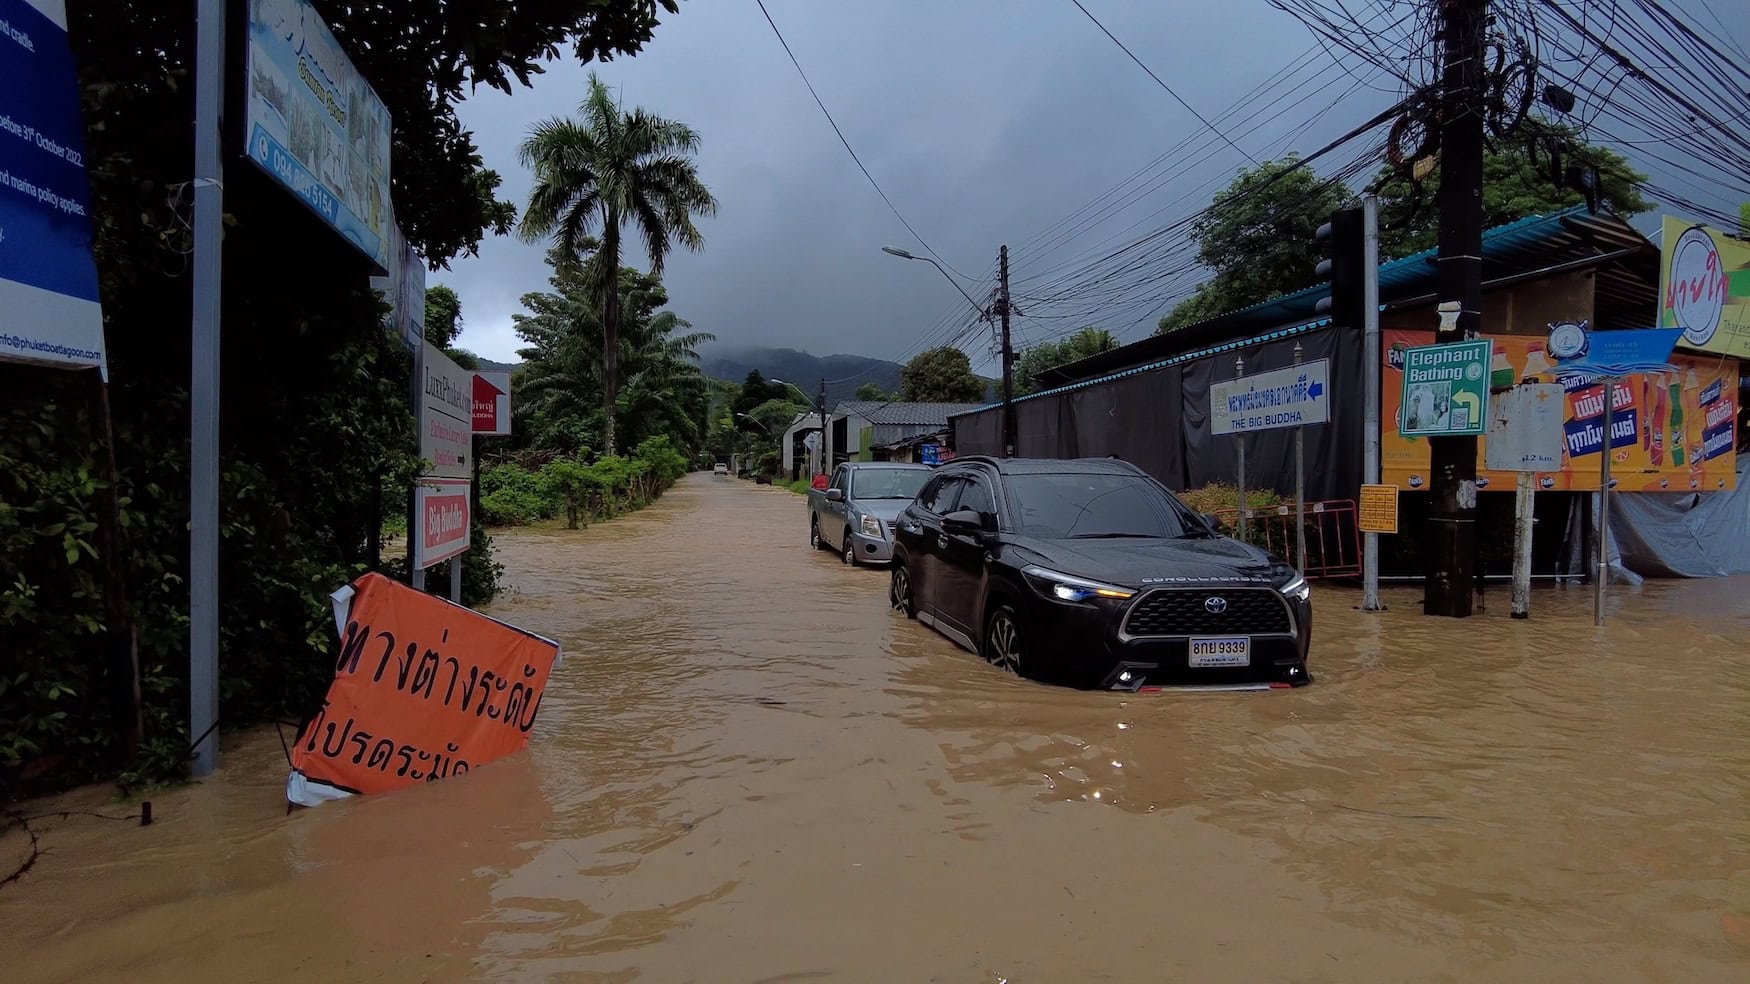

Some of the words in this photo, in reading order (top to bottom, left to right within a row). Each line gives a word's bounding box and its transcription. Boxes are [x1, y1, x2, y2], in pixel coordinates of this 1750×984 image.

[35, 132, 65, 158] October
[65, 147, 85, 167] 2022.
[11, 175, 37, 197] marina
[37, 187, 59, 209] policy
[59, 197, 88, 216] applies.
[273, 149, 292, 183] 094
[312, 186, 333, 217] 5154
[1410, 366, 1463, 382] Bathing
[1411, 347, 1481, 366] Elephant
[1232, 418, 1246, 430] THE
[1249, 416, 1262, 427] BIG
[1265, 411, 1302, 425] BUDDHA
[429, 505, 441, 542] Big
[441, 503, 463, 533] Buddha
[1193, 642, 1217, 655] 8กย
[1219, 641, 1245, 654] 9339
[336, 620, 544, 733] ทางต่างระดับ
